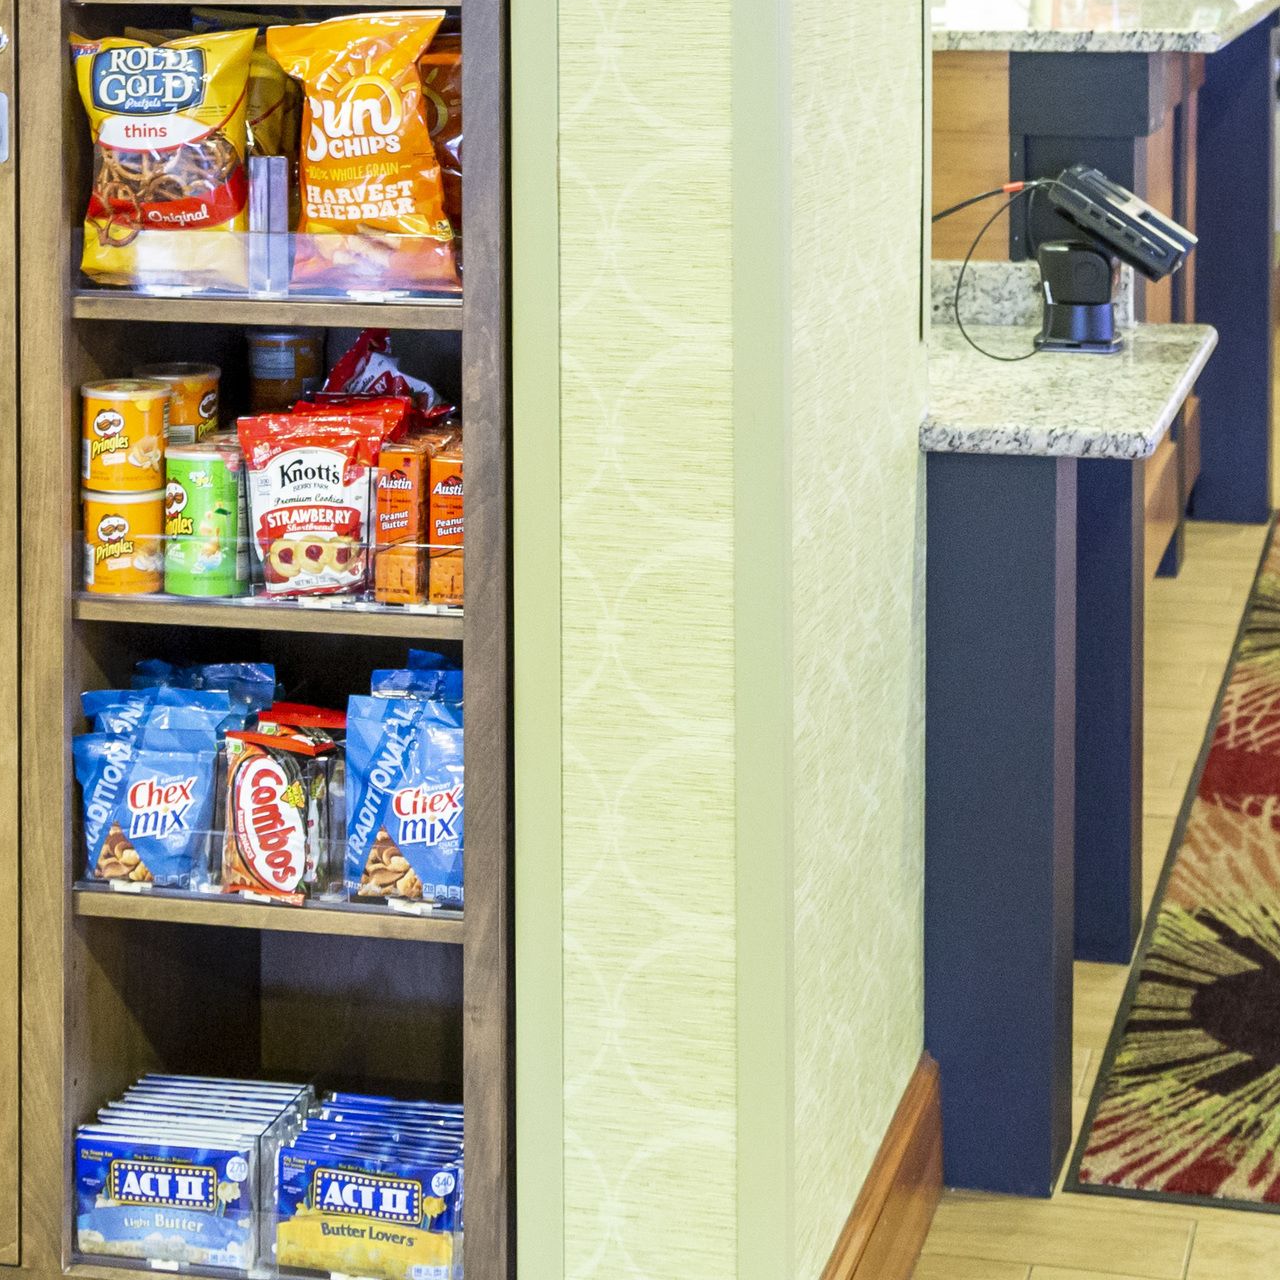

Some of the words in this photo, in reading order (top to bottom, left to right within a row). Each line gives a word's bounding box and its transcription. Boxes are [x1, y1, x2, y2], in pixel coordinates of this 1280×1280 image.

[99, 72, 192, 104] GOLD
[125, 98, 162, 109] Pretzels
[124, 123, 167, 138] thins
[328, 135, 401, 159] CHIPS
[330, 166, 365, 182] WHOLE
[366, 161, 399, 178] GRAIN
[306, 180, 414, 205] HARVEST
[148, 203, 209, 227] Original
[306, 196, 416, 221] CHEDDAR
[92, 436, 129, 461] Pringles
[280, 460, 340, 488] Knott's
[378, 476, 412, 489] Austin
[433, 481, 464, 495] Austi
[274, 496, 312, 507] Premium
[314, 494, 344, 504] Cookies
[267, 508, 352, 528] STRAWBERRY
[286, 523, 335, 532] Shortbread
[380, 510, 409, 522] Peanut
[382, 520, 409, 531] Butter
[96, 540, 134, 565] Pringles
[130, 778, 194, 809] Chex
[133, 804, 189, 837] mix
[251, 768, 297, 884] Combos
[402, 811, 458, 843] mix
[122, 1171, 172, 1198] ACT
[176, 1175, 205, 1200] II
[435, 1175, 452, 1189] 340
[323, 1181, 375, 1209] ACT
[379, 1187, 410, 1214] II
[154, 1213, 204, 1233] Butter
[321, 1222, 366, 1237] Butter
[369, 1227, 415, 1247] Lovers
